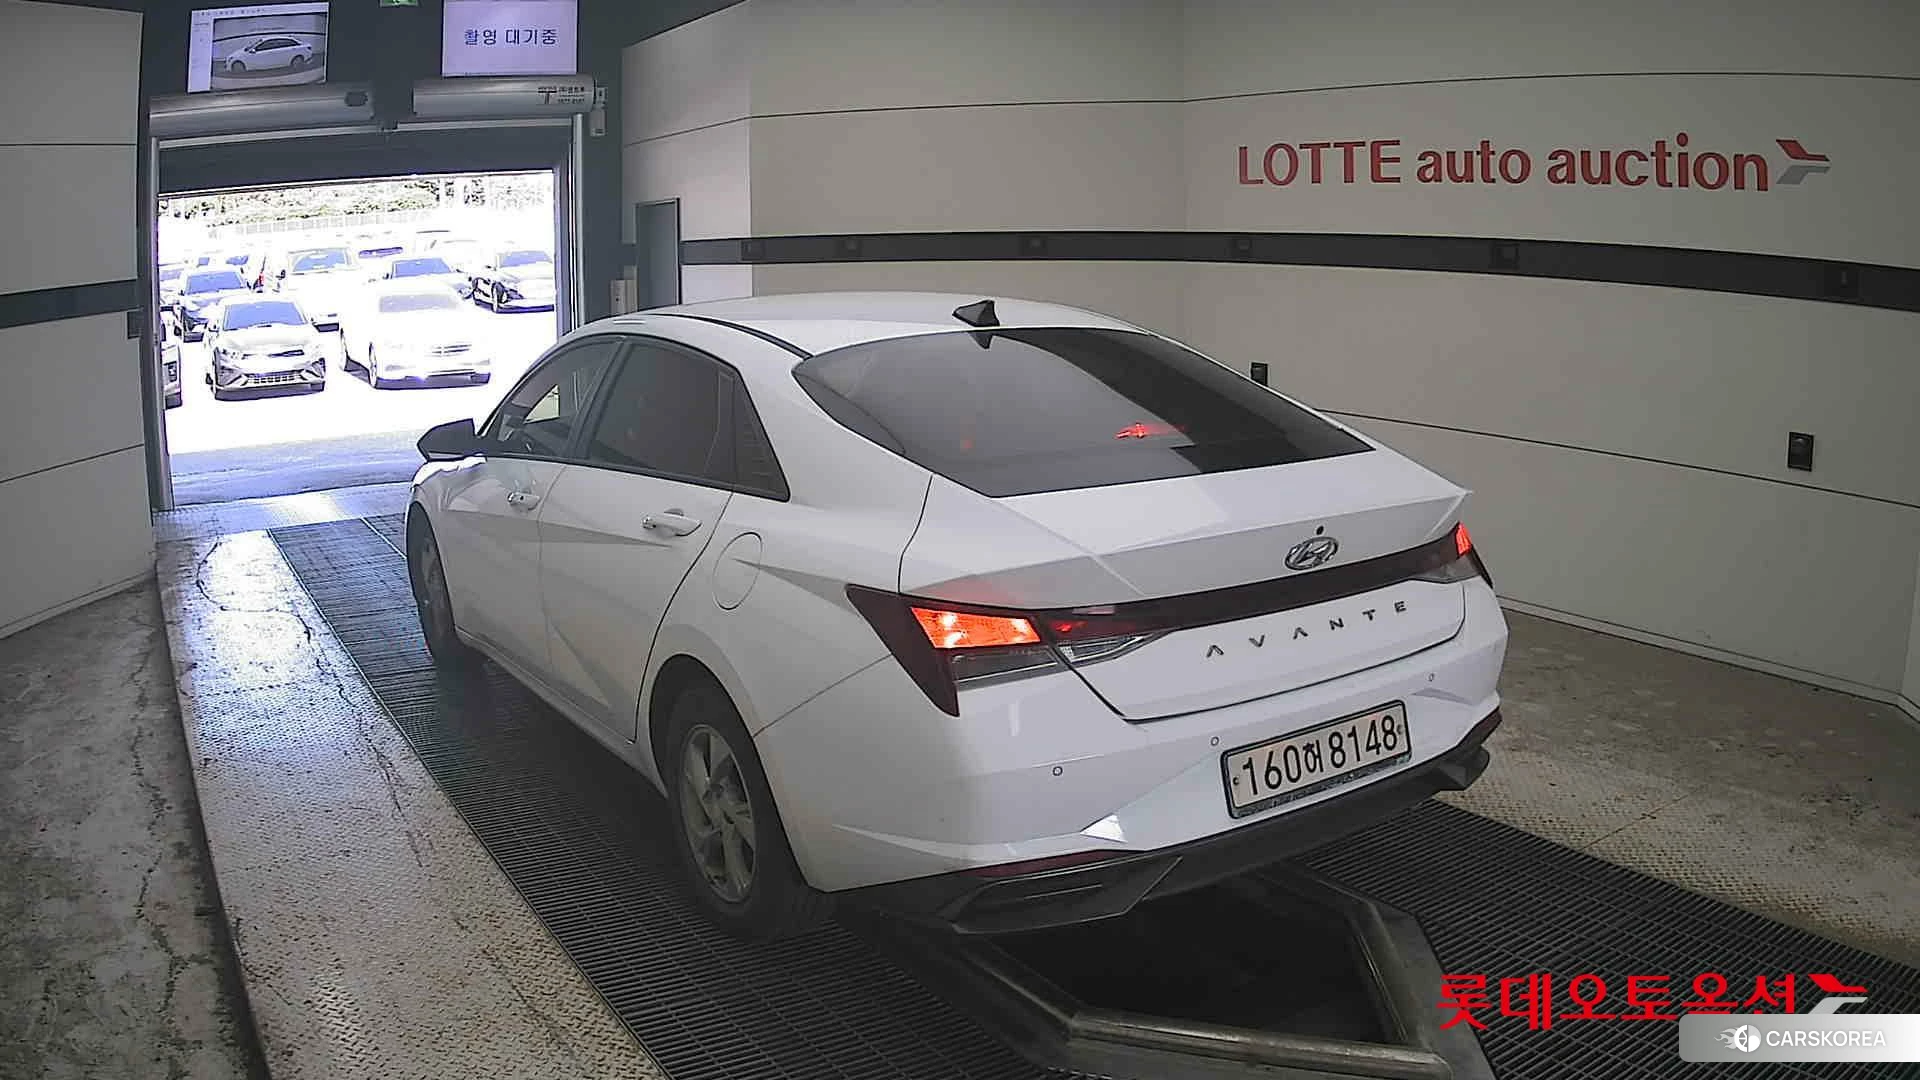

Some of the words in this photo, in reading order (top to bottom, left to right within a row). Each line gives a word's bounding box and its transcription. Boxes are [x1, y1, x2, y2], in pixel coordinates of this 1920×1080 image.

[463, 28, 497, 46] 촬영
[505, 28, 558, 46] 대기중
[1239, 140, 1401, 186] LOTTE
[1416, 140, 1532, 184] auto
[1547, 132, 1769, 192] auction
[1205, 600, 1408, 659] AVANTE
